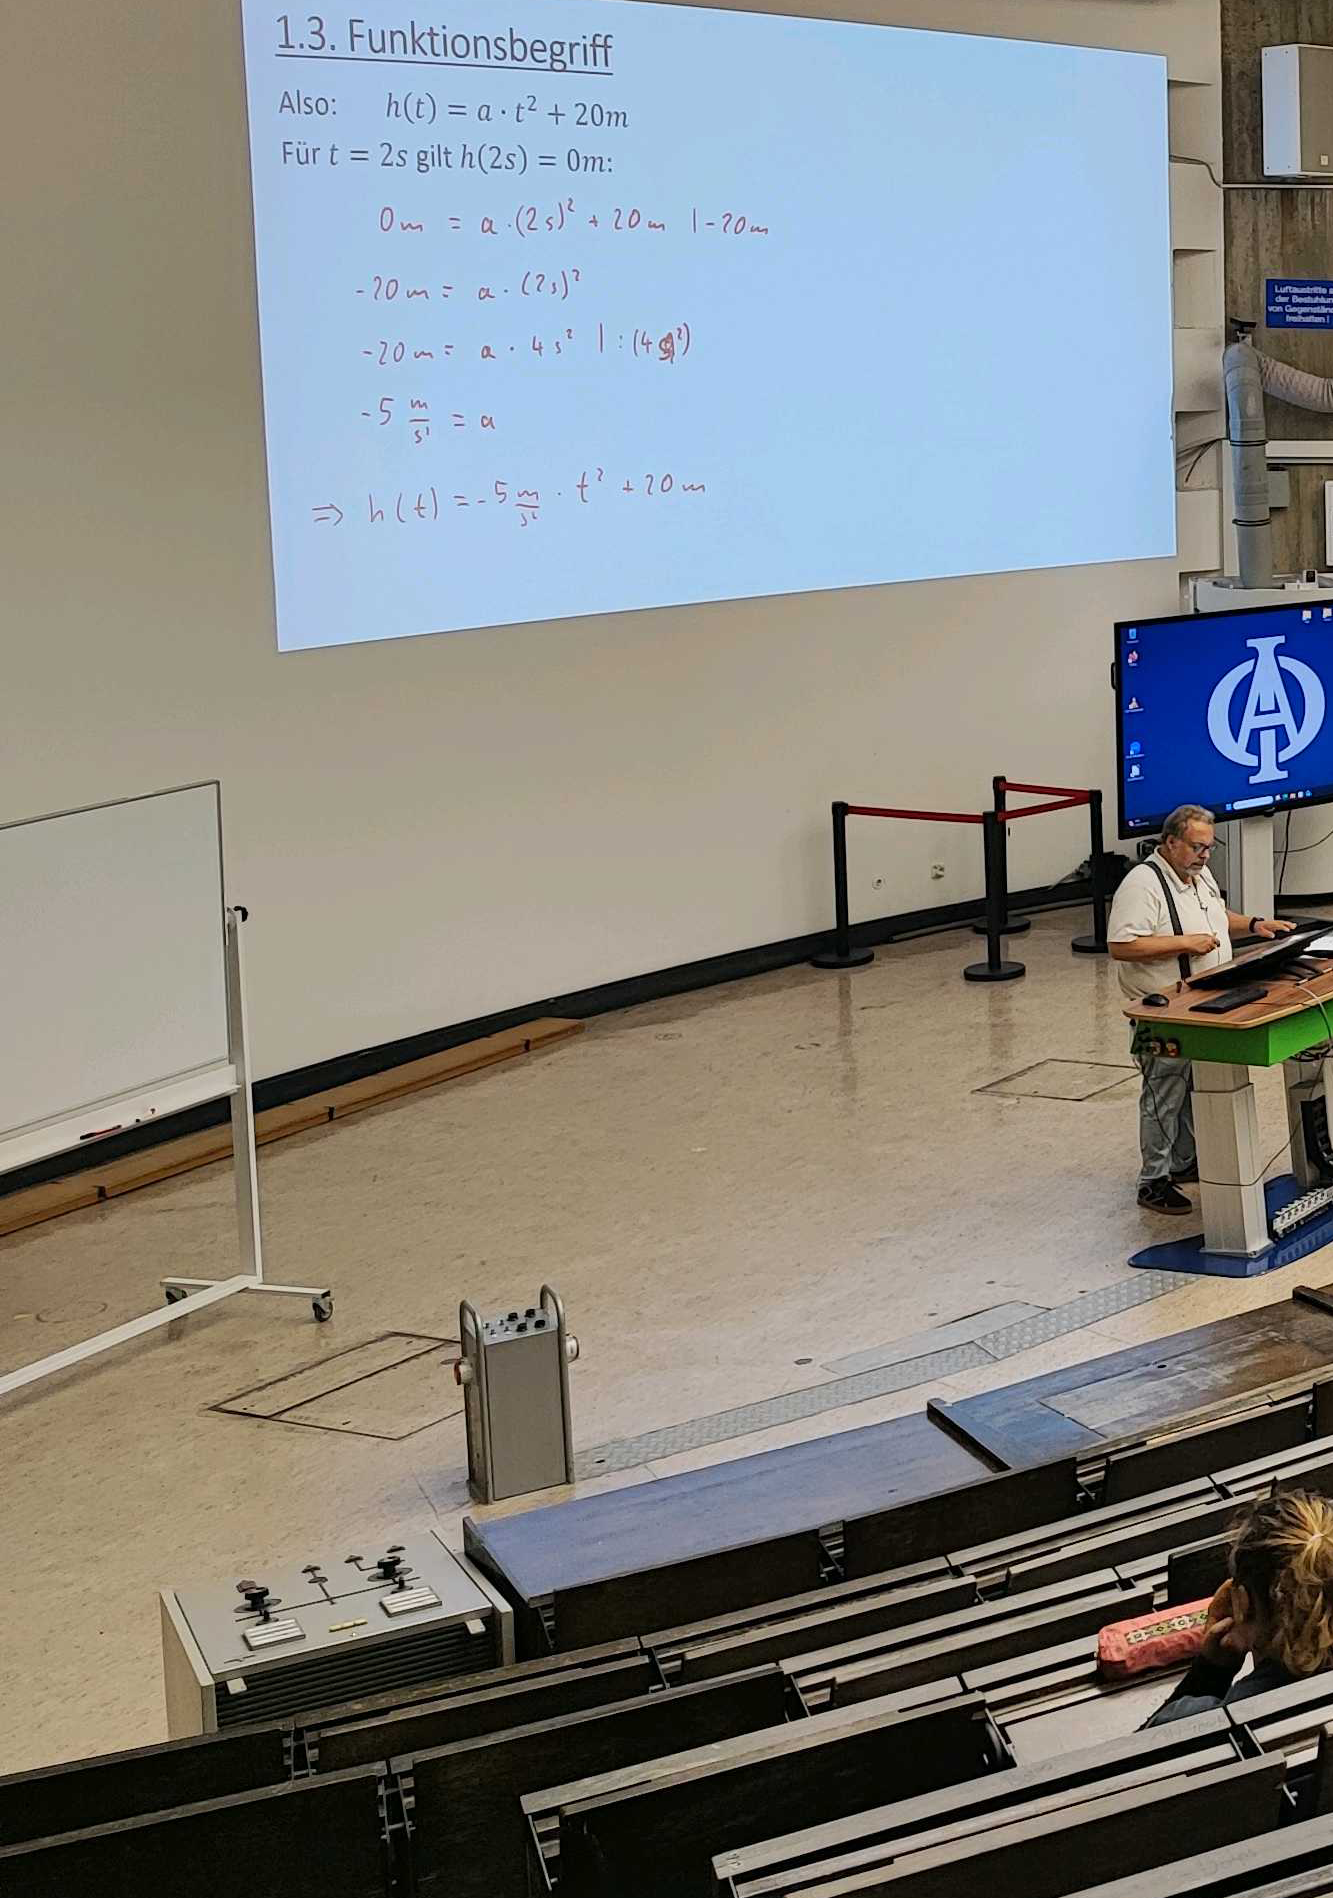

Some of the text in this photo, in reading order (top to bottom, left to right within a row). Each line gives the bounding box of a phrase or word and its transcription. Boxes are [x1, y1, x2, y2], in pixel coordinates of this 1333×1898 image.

[276, 15, 615, 73] 1.3. Funktionsbegriff
[278, 89, 337, 116] Also:
[282, 141, 321, 166] Für
[416, 143, 453, 174] gilt
